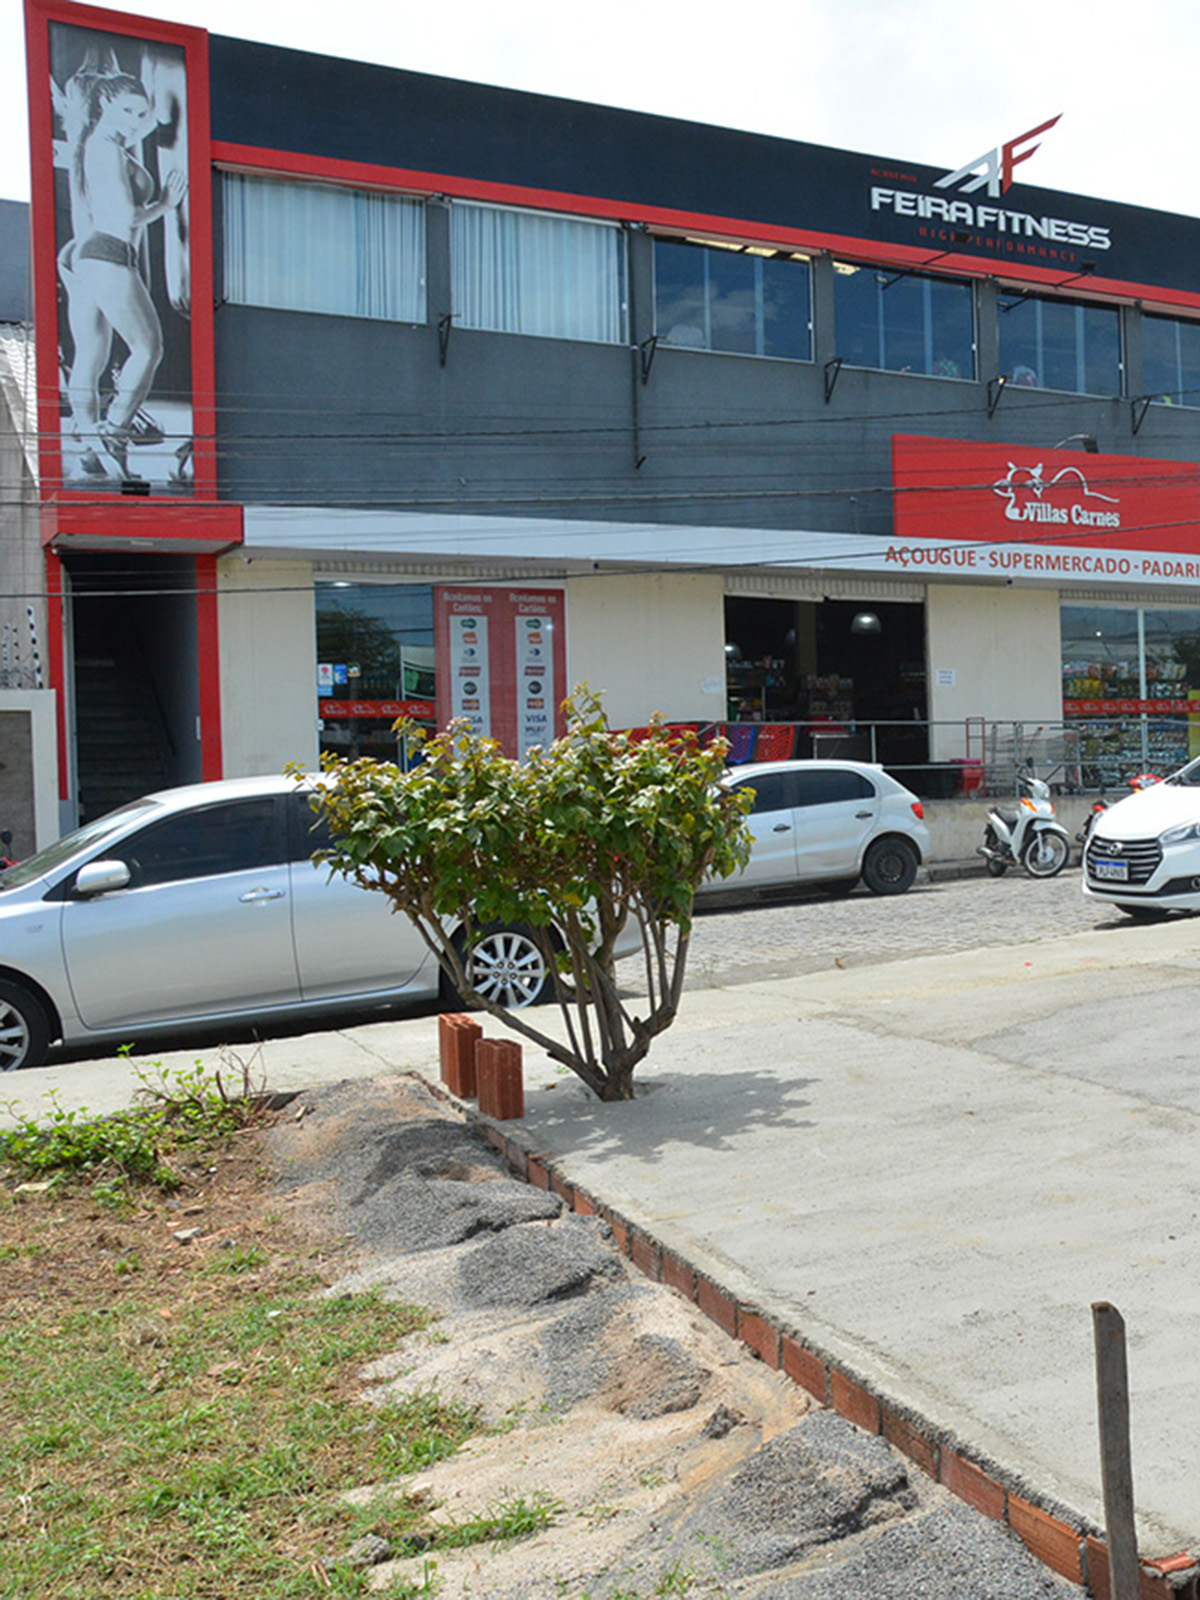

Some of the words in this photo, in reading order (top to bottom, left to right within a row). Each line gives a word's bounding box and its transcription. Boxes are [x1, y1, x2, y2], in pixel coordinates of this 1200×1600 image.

[870, 186, 974, 227] FEIRA
[975, 204, 1112, 251] FITNESS
[1024, 501, 1069, 524] Villas
[1070, 503, 1121, 528] Carnes
[885, 545, 977, 567] AÇOUGUE
[988, 550, 1132, 575] SUPERMERCADO
